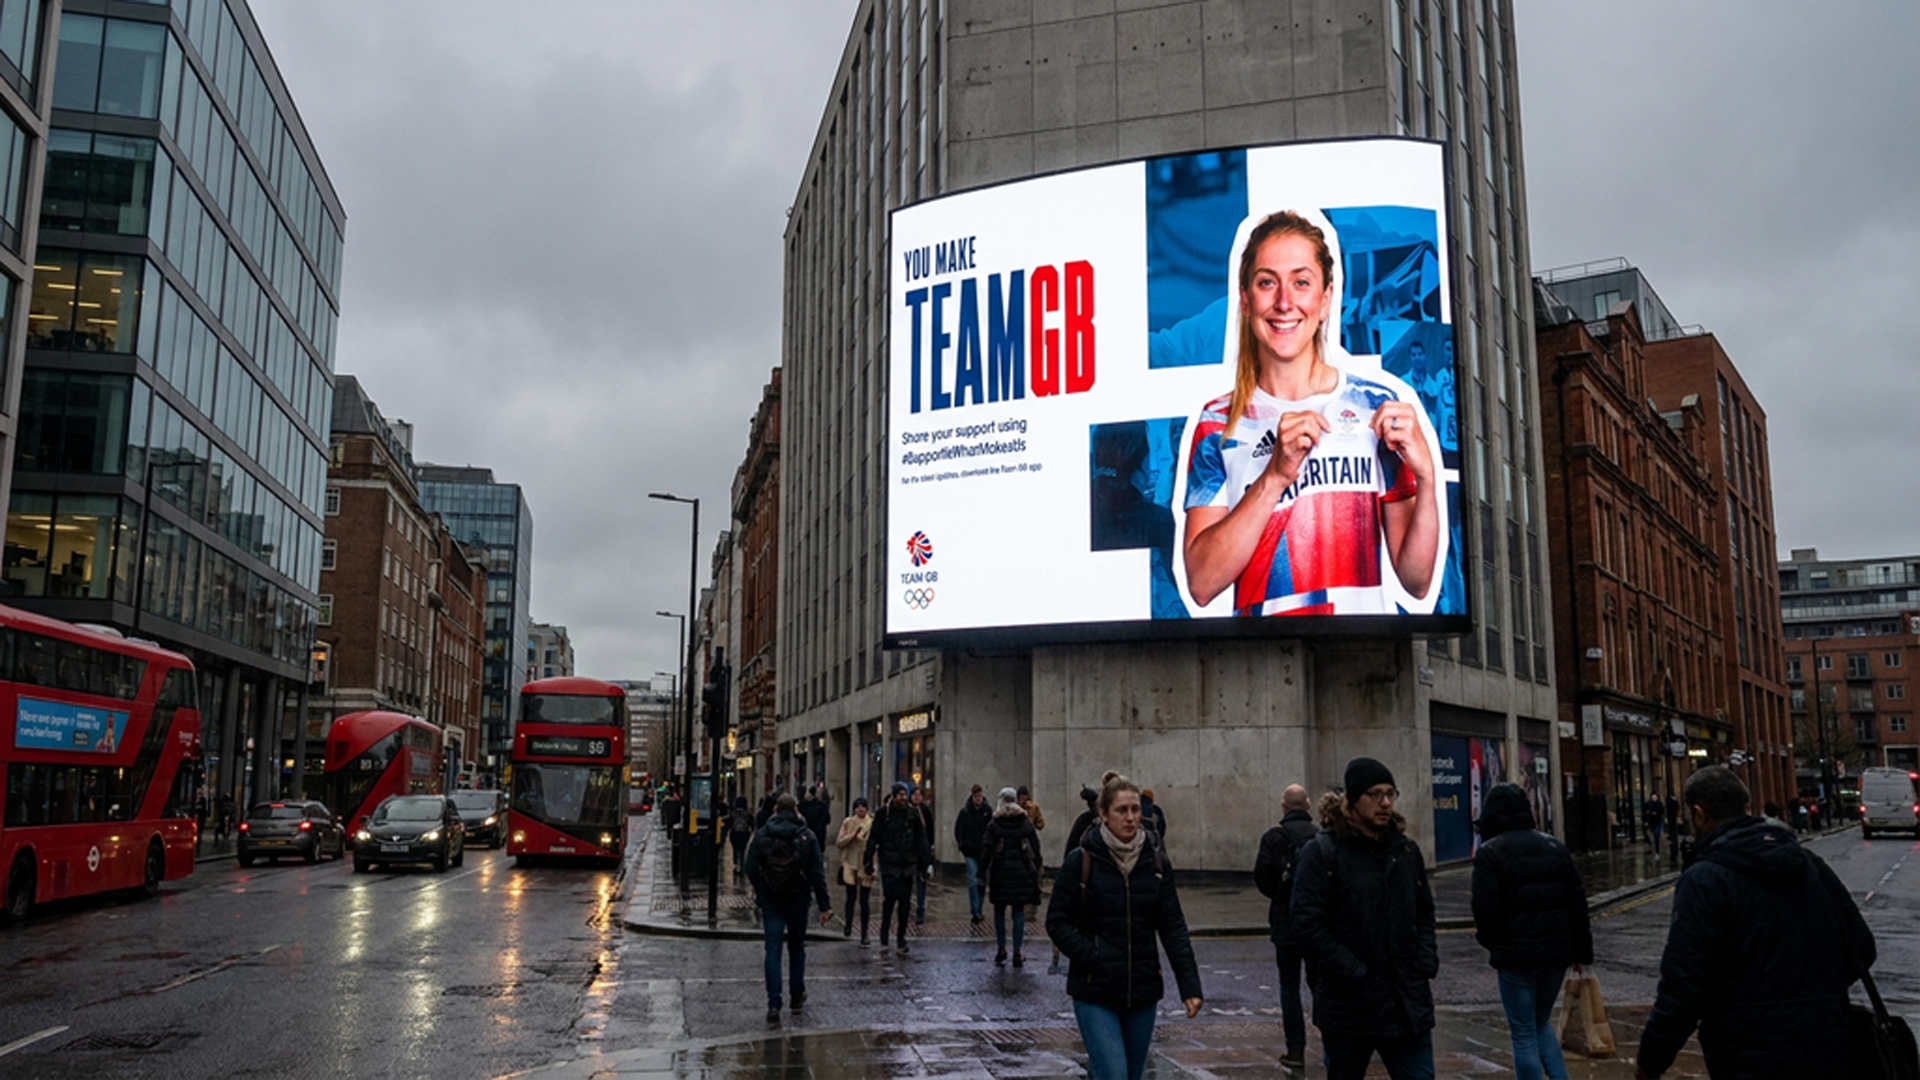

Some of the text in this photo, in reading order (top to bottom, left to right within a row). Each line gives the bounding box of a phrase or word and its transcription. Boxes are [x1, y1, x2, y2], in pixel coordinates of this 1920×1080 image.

[904, 236, 976, 282] YOU MAKE
[901, 417, 1027, 445] Share your support using
[901, 572, 923, 584] TEAM
